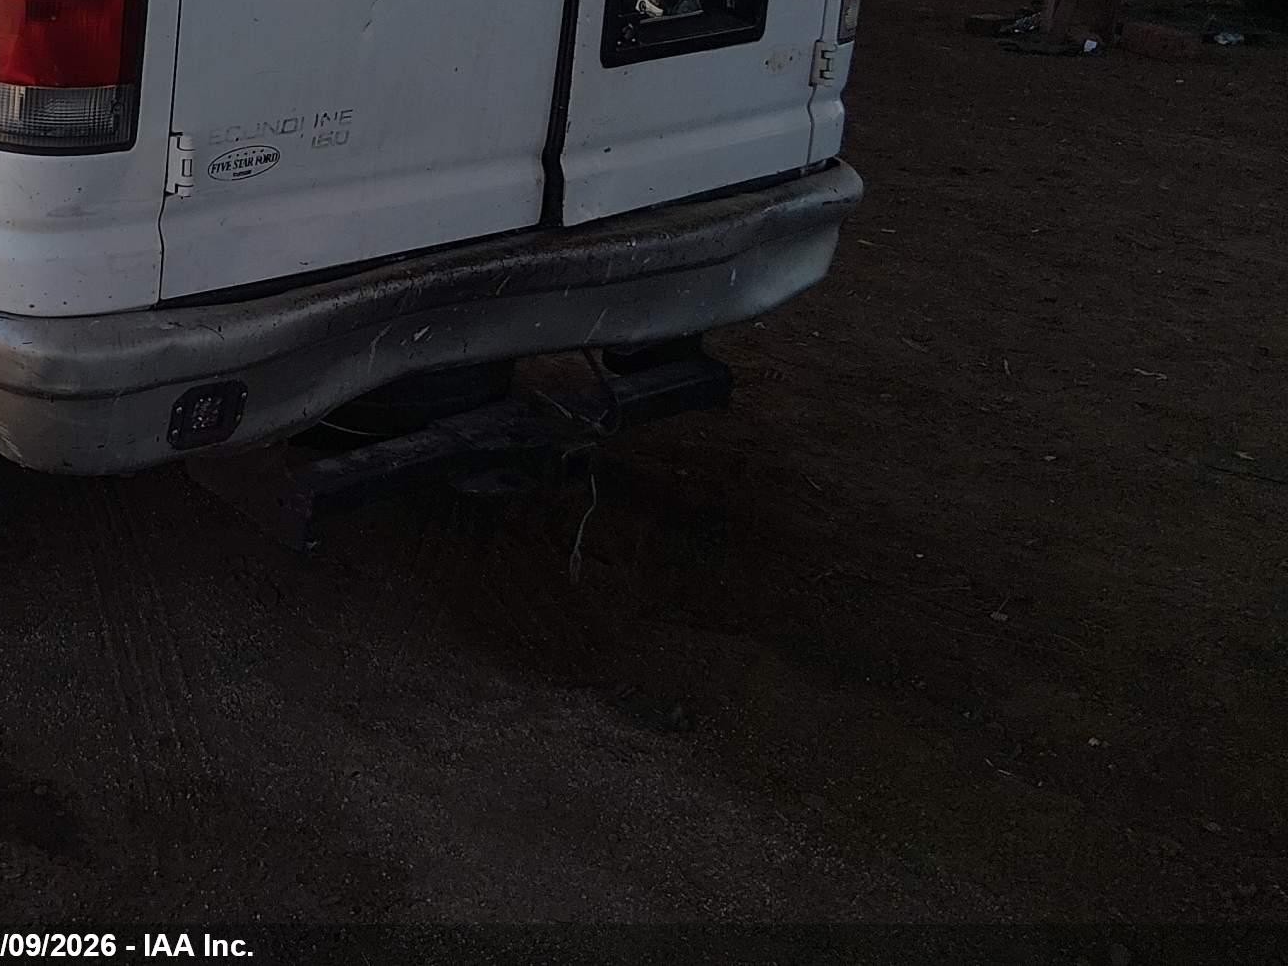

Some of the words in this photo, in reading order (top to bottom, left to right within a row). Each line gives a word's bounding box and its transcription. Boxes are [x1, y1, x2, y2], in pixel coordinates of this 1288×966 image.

[211, 161, 232, 174] FIVE
[232, 156, 254, 170] STAR
[254, 152, 279, 166] FORD
